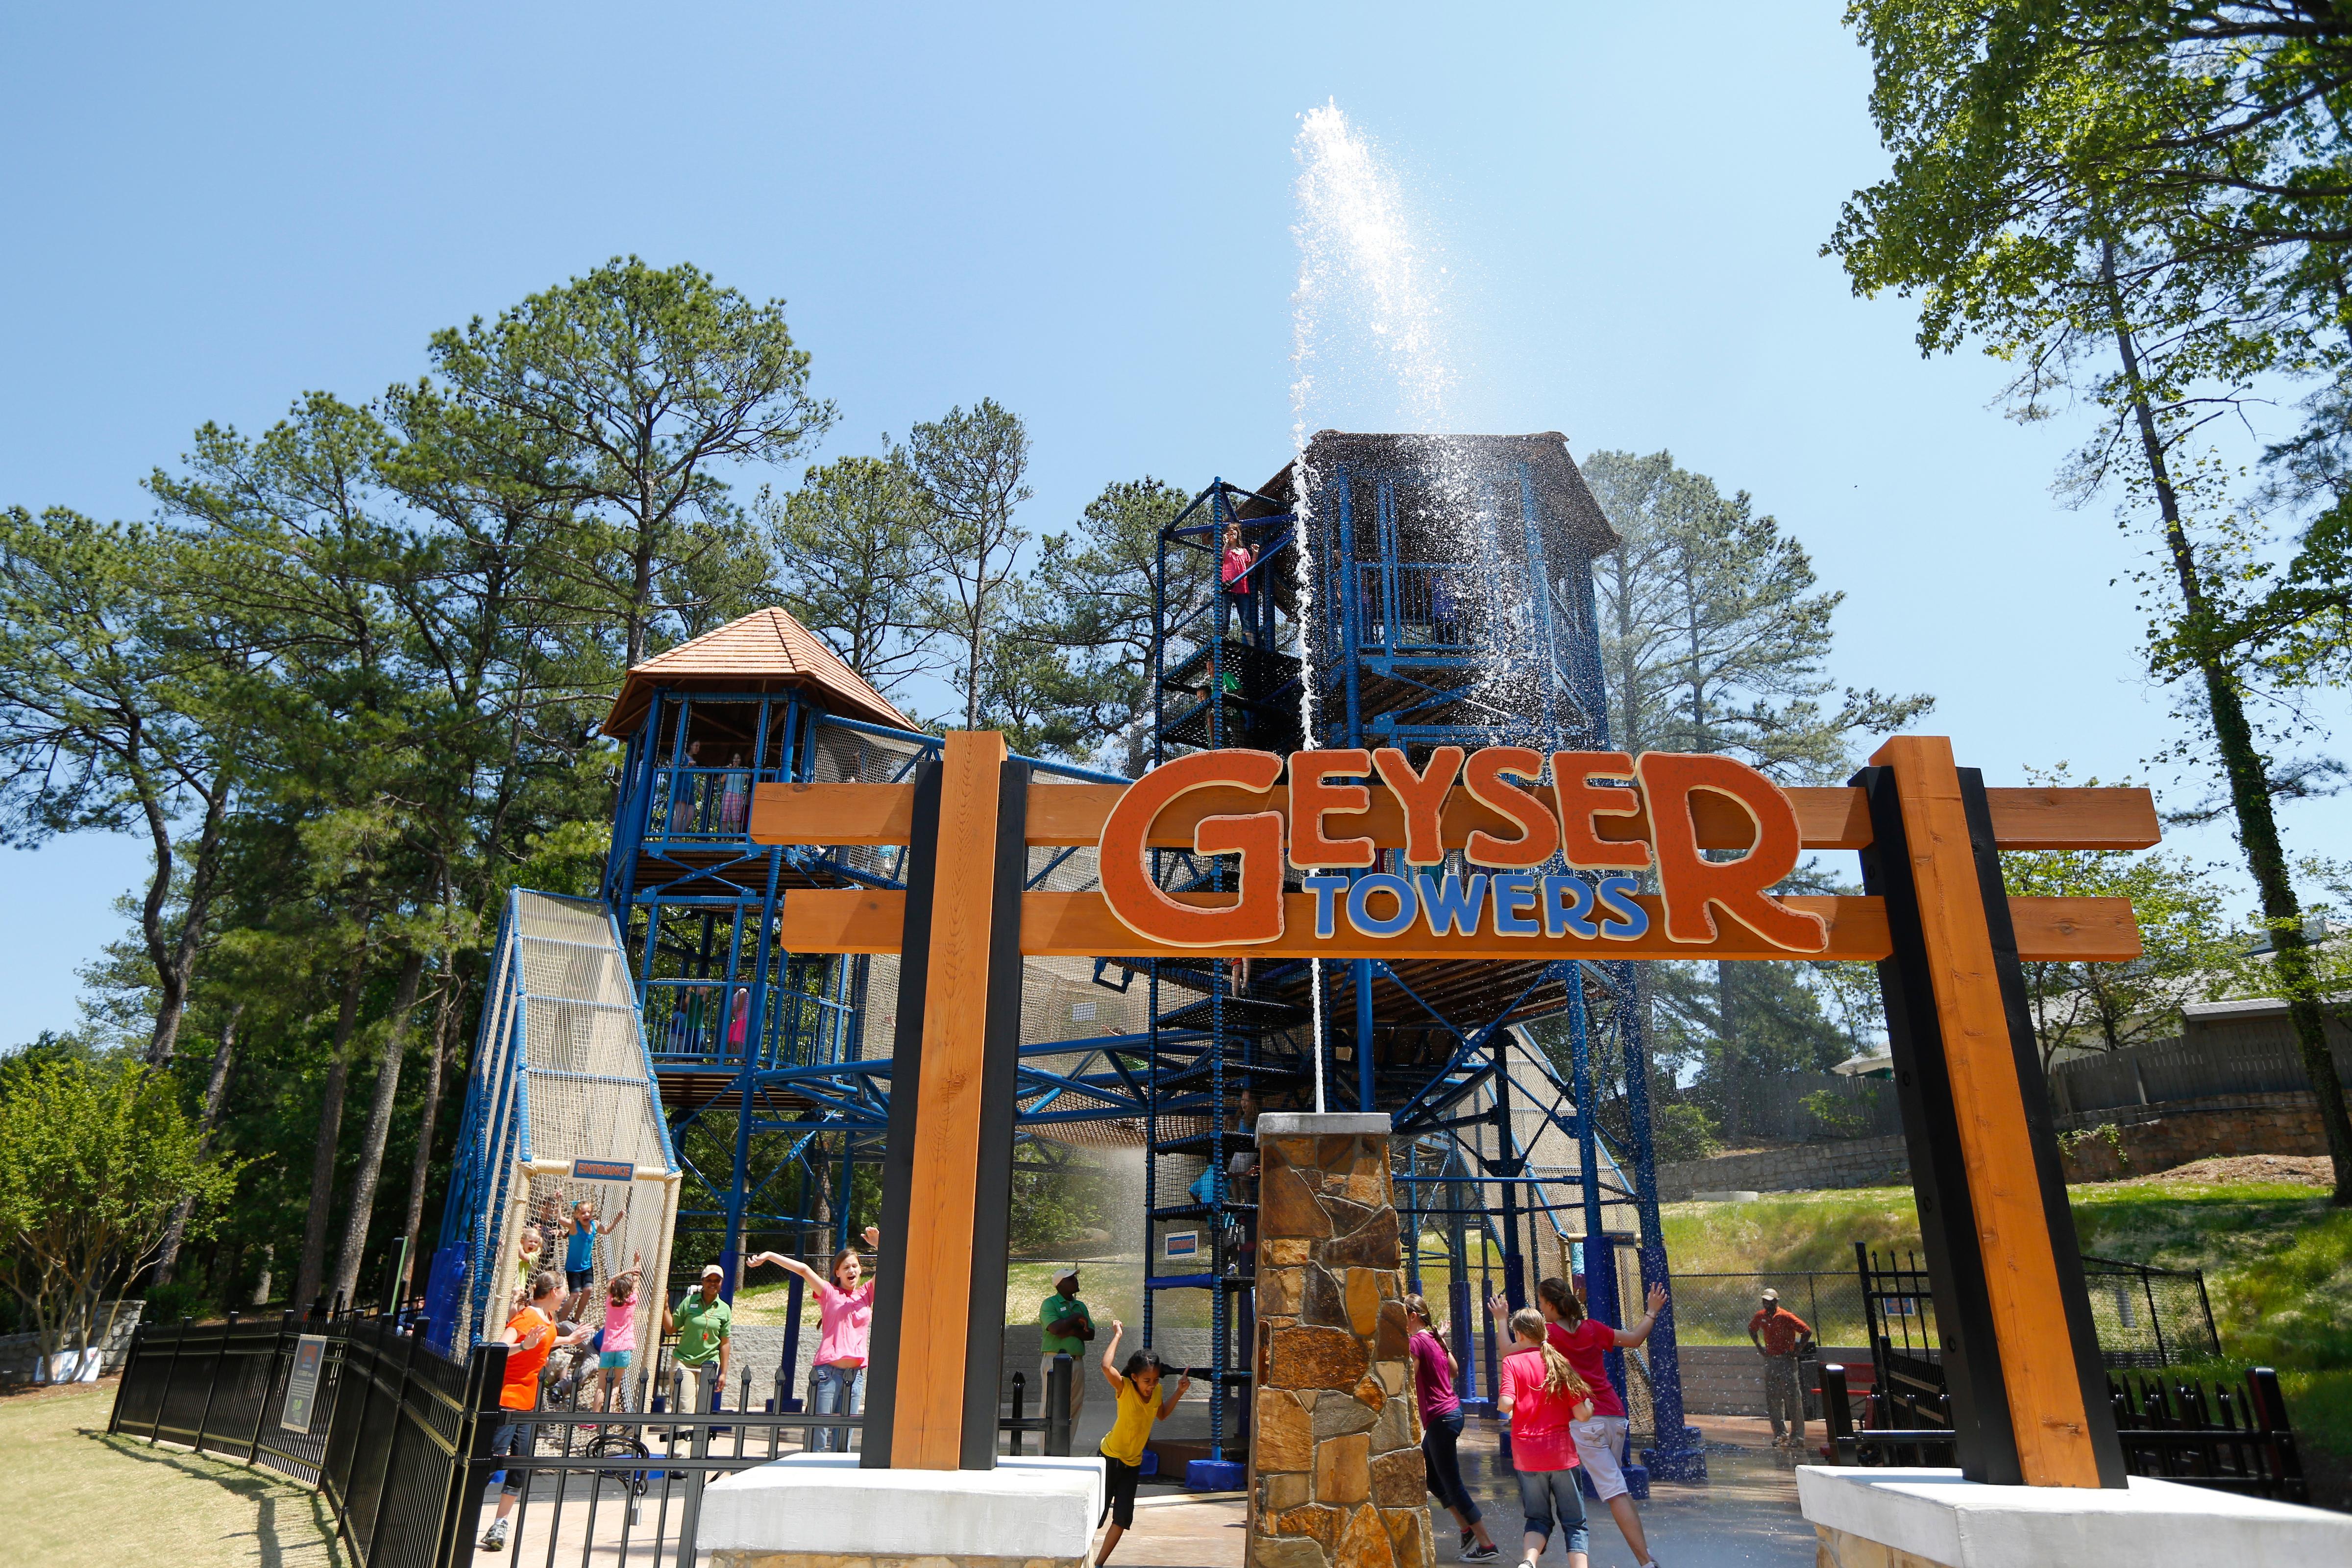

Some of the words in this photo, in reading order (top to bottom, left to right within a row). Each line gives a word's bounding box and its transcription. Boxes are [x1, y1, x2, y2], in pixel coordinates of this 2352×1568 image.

[1098, 746, 1828, 953] GEYSER
[1301, 873, 1649, 941] TOWERS
[577, 1163, 631, 1176] ENTRANCE
[1169, 1239, 1194, 1250] ENTRANCE
